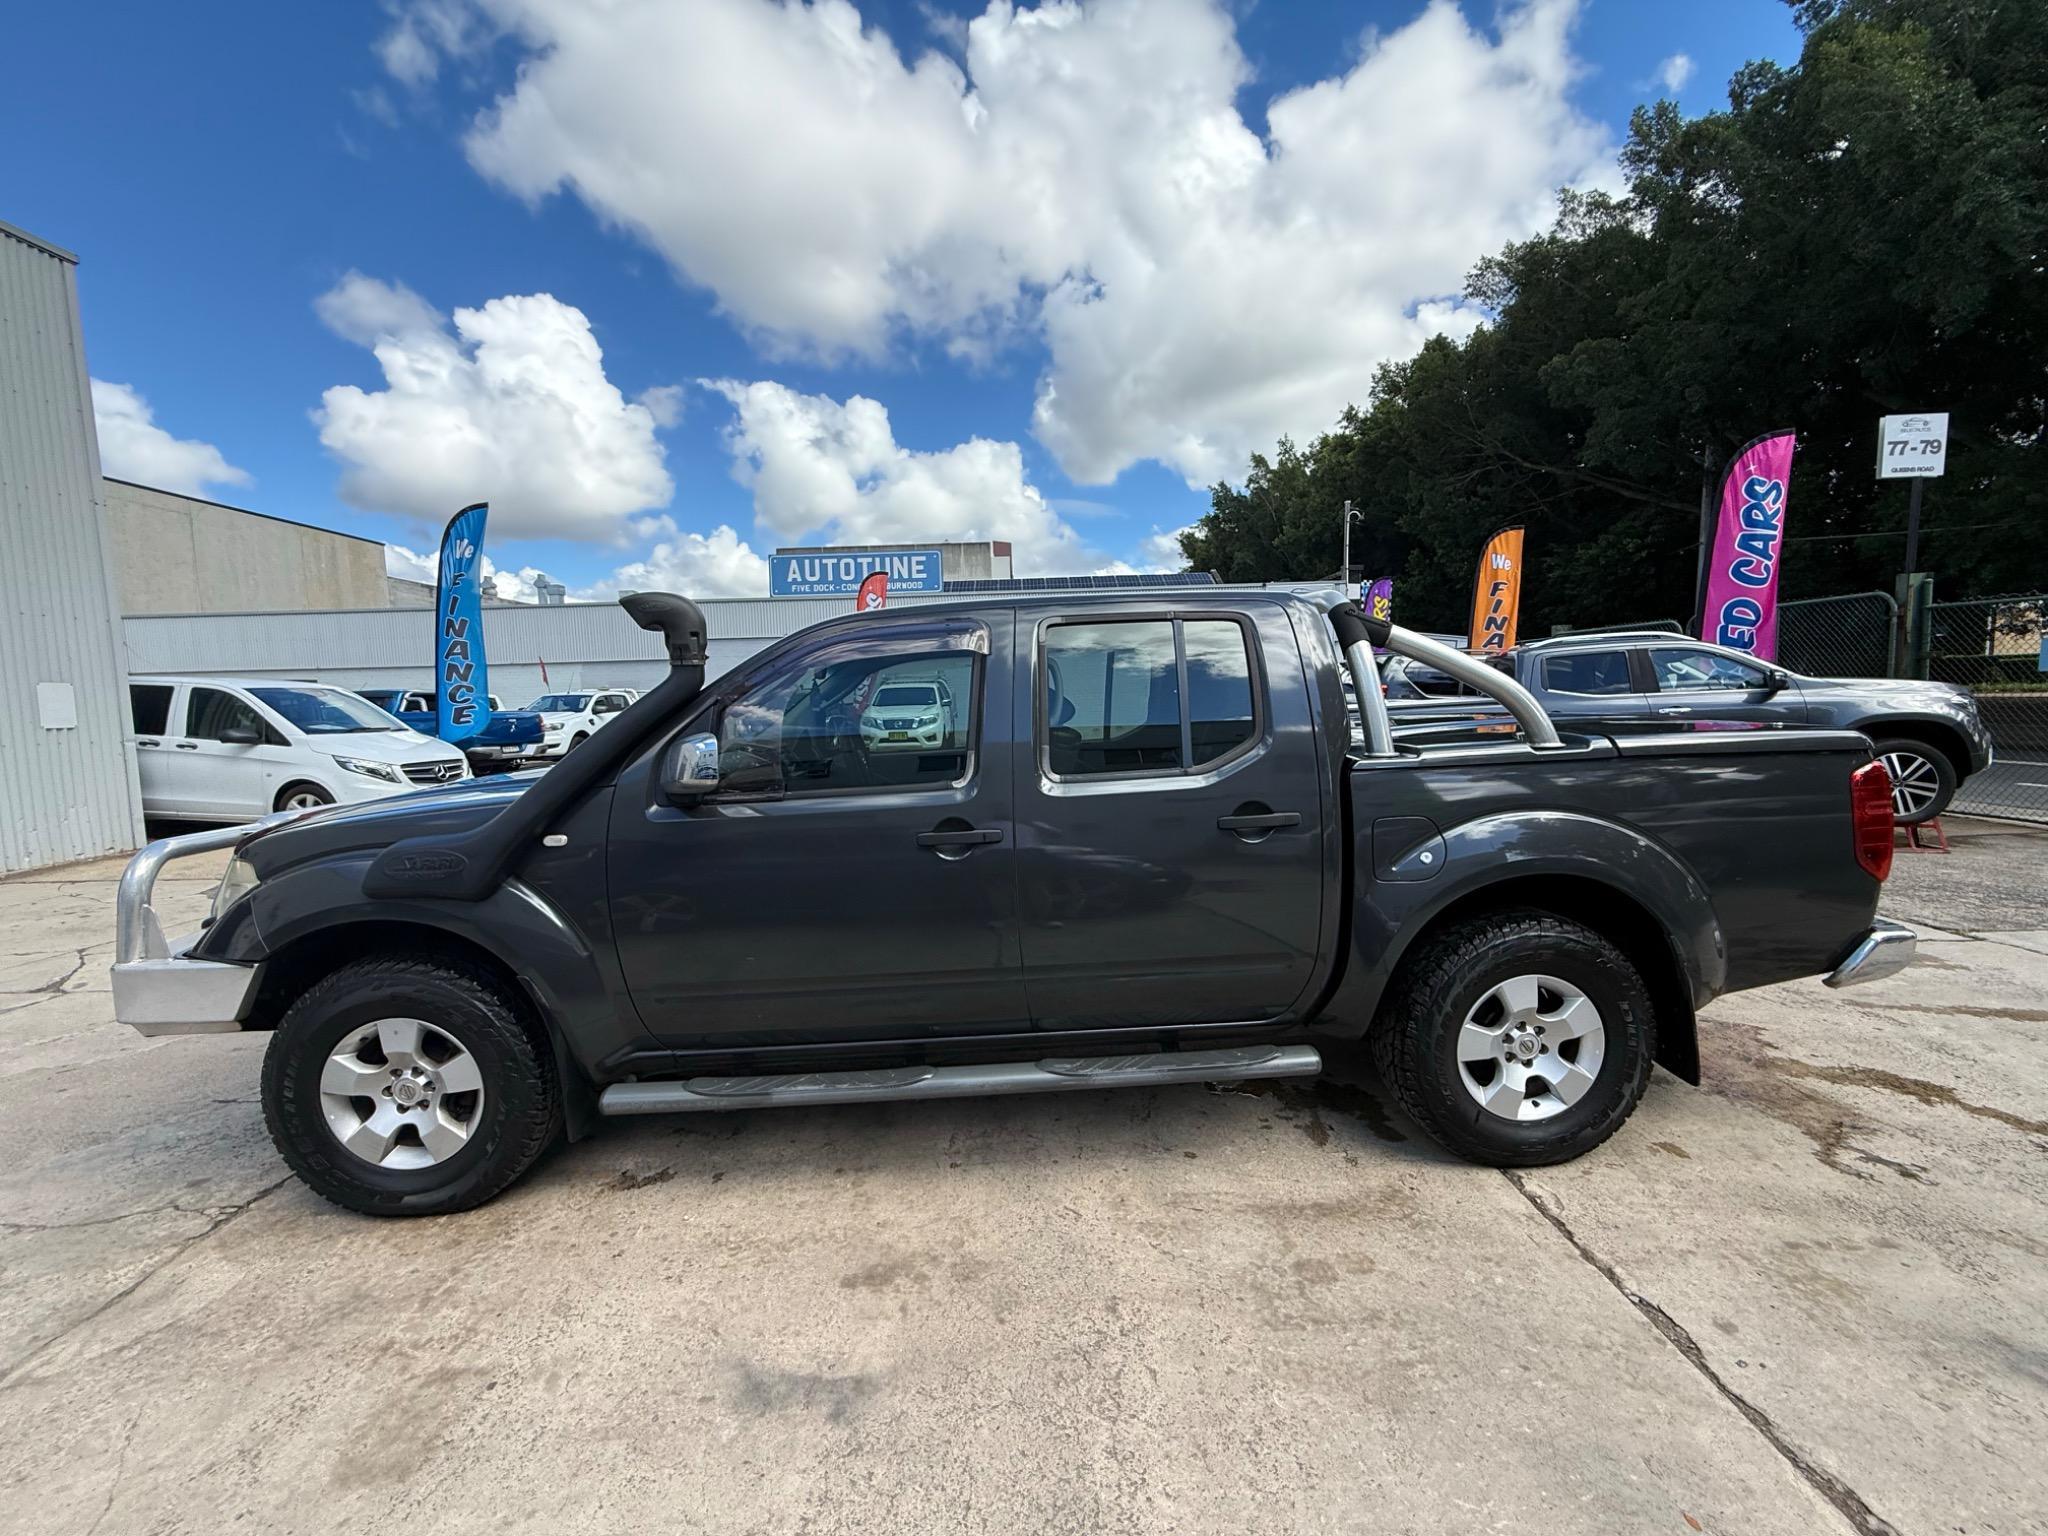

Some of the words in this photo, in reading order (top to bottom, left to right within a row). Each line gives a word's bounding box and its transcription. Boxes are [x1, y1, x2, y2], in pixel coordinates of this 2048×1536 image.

[455, 538, 474, 560] We
[1729, 474, 1784, 588] CARS
[787, 555, 927, 582] AUTOTUNE
[1491, 553, 1512, 571] We
[1716, 597, 1762, 655] ED
[444, 572, 477, 726] FINANCE
